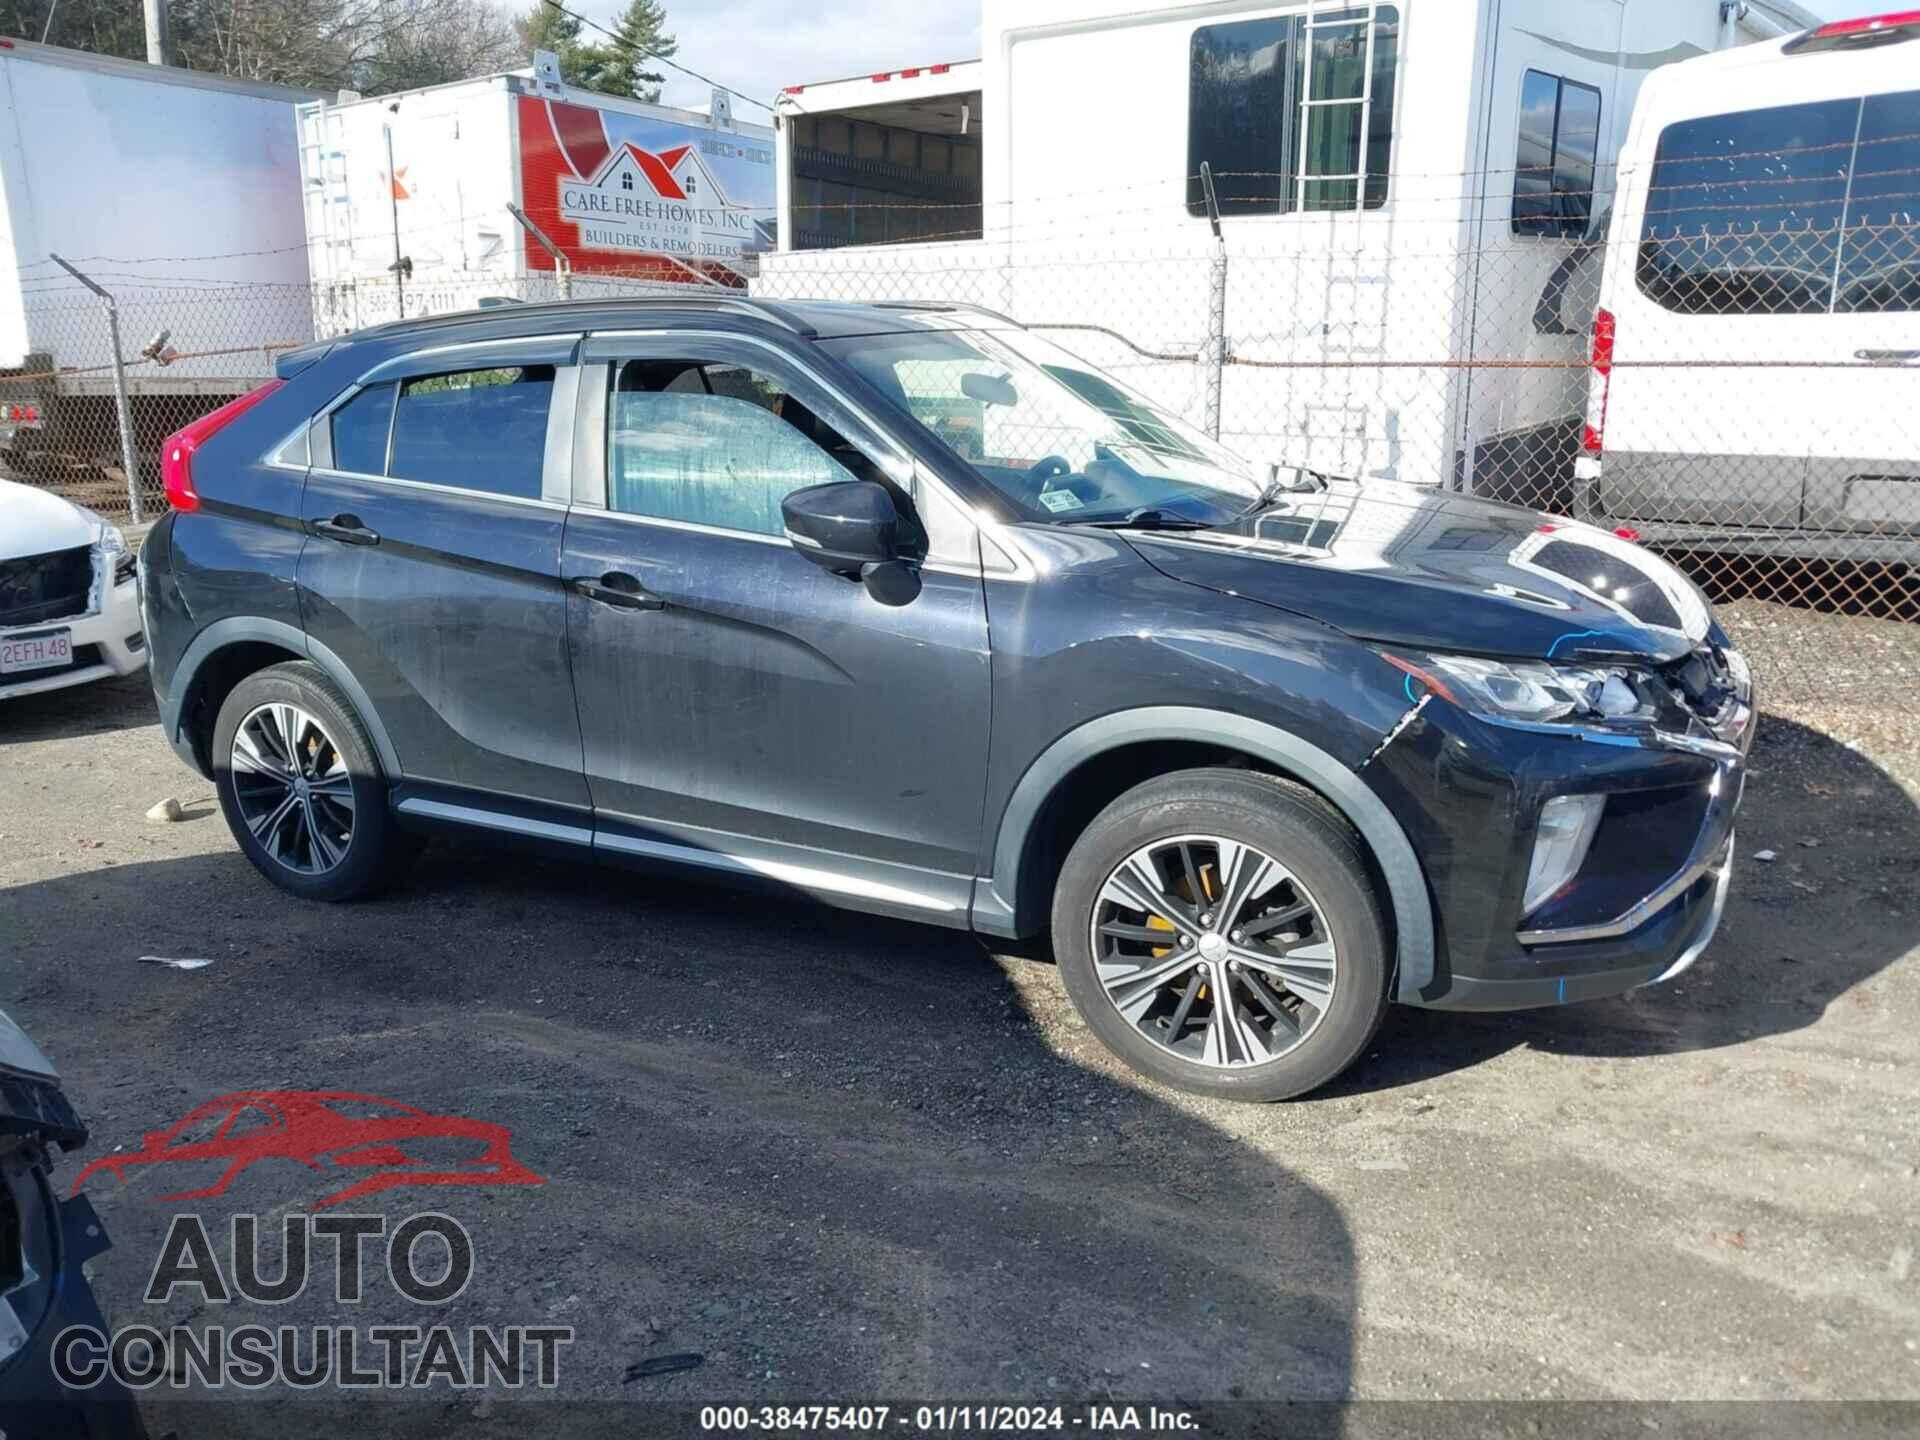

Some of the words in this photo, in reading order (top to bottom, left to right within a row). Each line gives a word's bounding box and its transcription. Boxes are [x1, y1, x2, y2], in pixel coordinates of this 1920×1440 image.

[564, 190, 608, 213] CARE
[615, 197, 653, 218] FREE
[585, 230, 647, 248] BUILDERS
[650, 236, 658, 249] &
[663, 238, 737, 258] REMODELERS
[3, 642, 45, 664] 2EFH
[48, 639, 68, 657] 48
